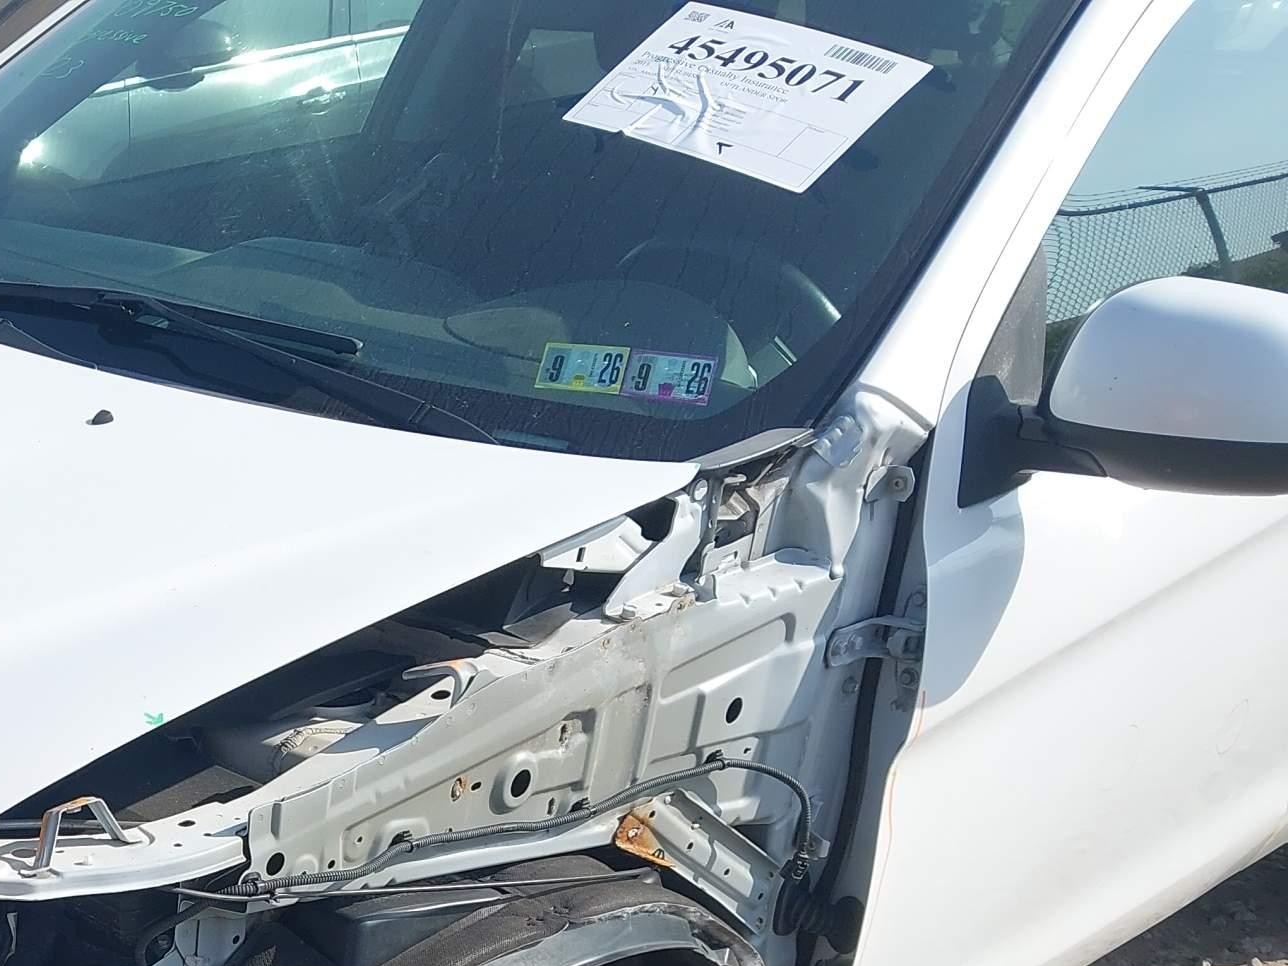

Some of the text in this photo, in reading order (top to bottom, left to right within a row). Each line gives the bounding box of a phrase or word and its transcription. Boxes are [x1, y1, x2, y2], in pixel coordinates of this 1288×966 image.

[641, 50, 697, 69] Progressive
[741, 75, 790, 95] Insurance
[667, 34, 867, 104] 45495071
[548, 354, 565, 382] 9
[597, 352, 624, 386] 26
[634, 363, 652, 391] 9
[685, 361, 712, 395] 26
